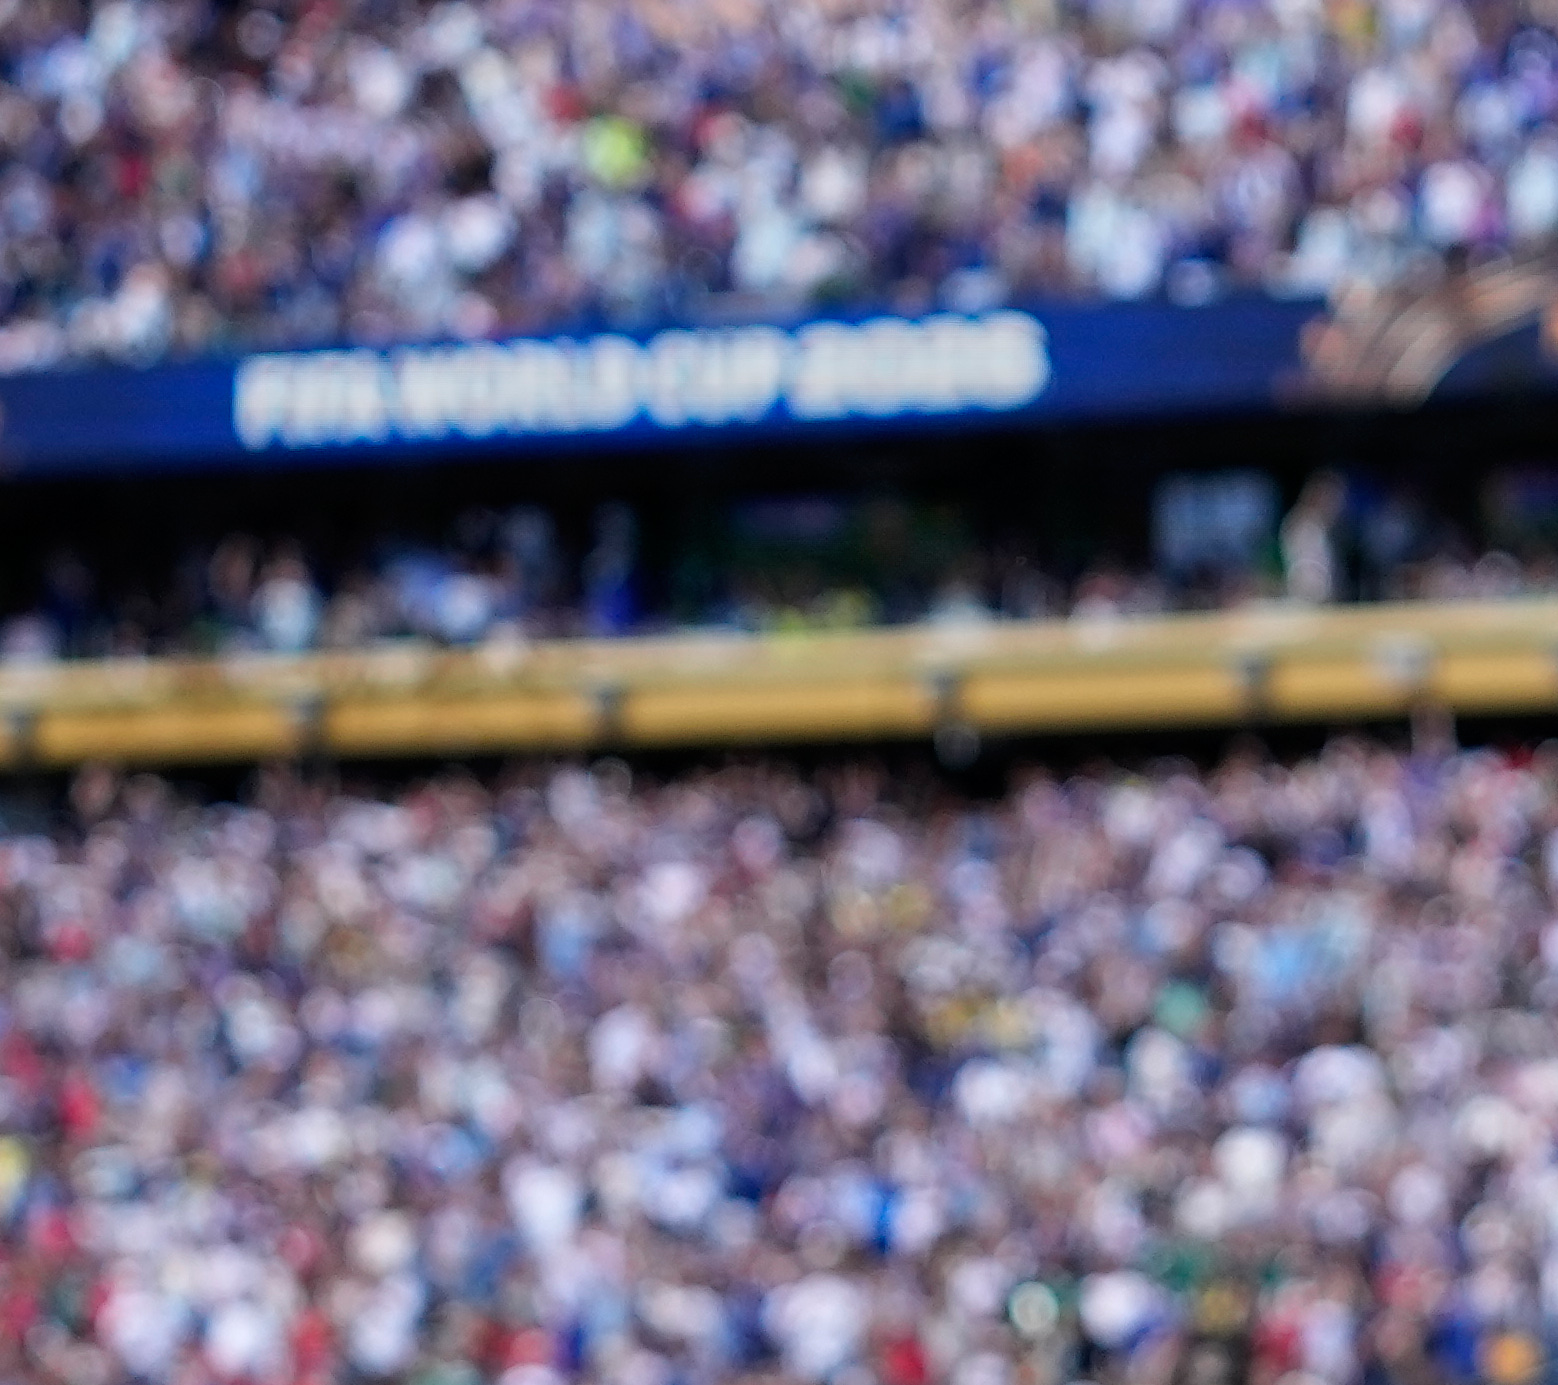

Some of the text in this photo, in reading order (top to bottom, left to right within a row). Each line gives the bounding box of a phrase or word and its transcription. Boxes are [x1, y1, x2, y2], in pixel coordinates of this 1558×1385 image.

[234, 350, 388, 449] FIFA
[392, 333, 645, 438] WORLD
[647, 325, 785, 428] CUP
